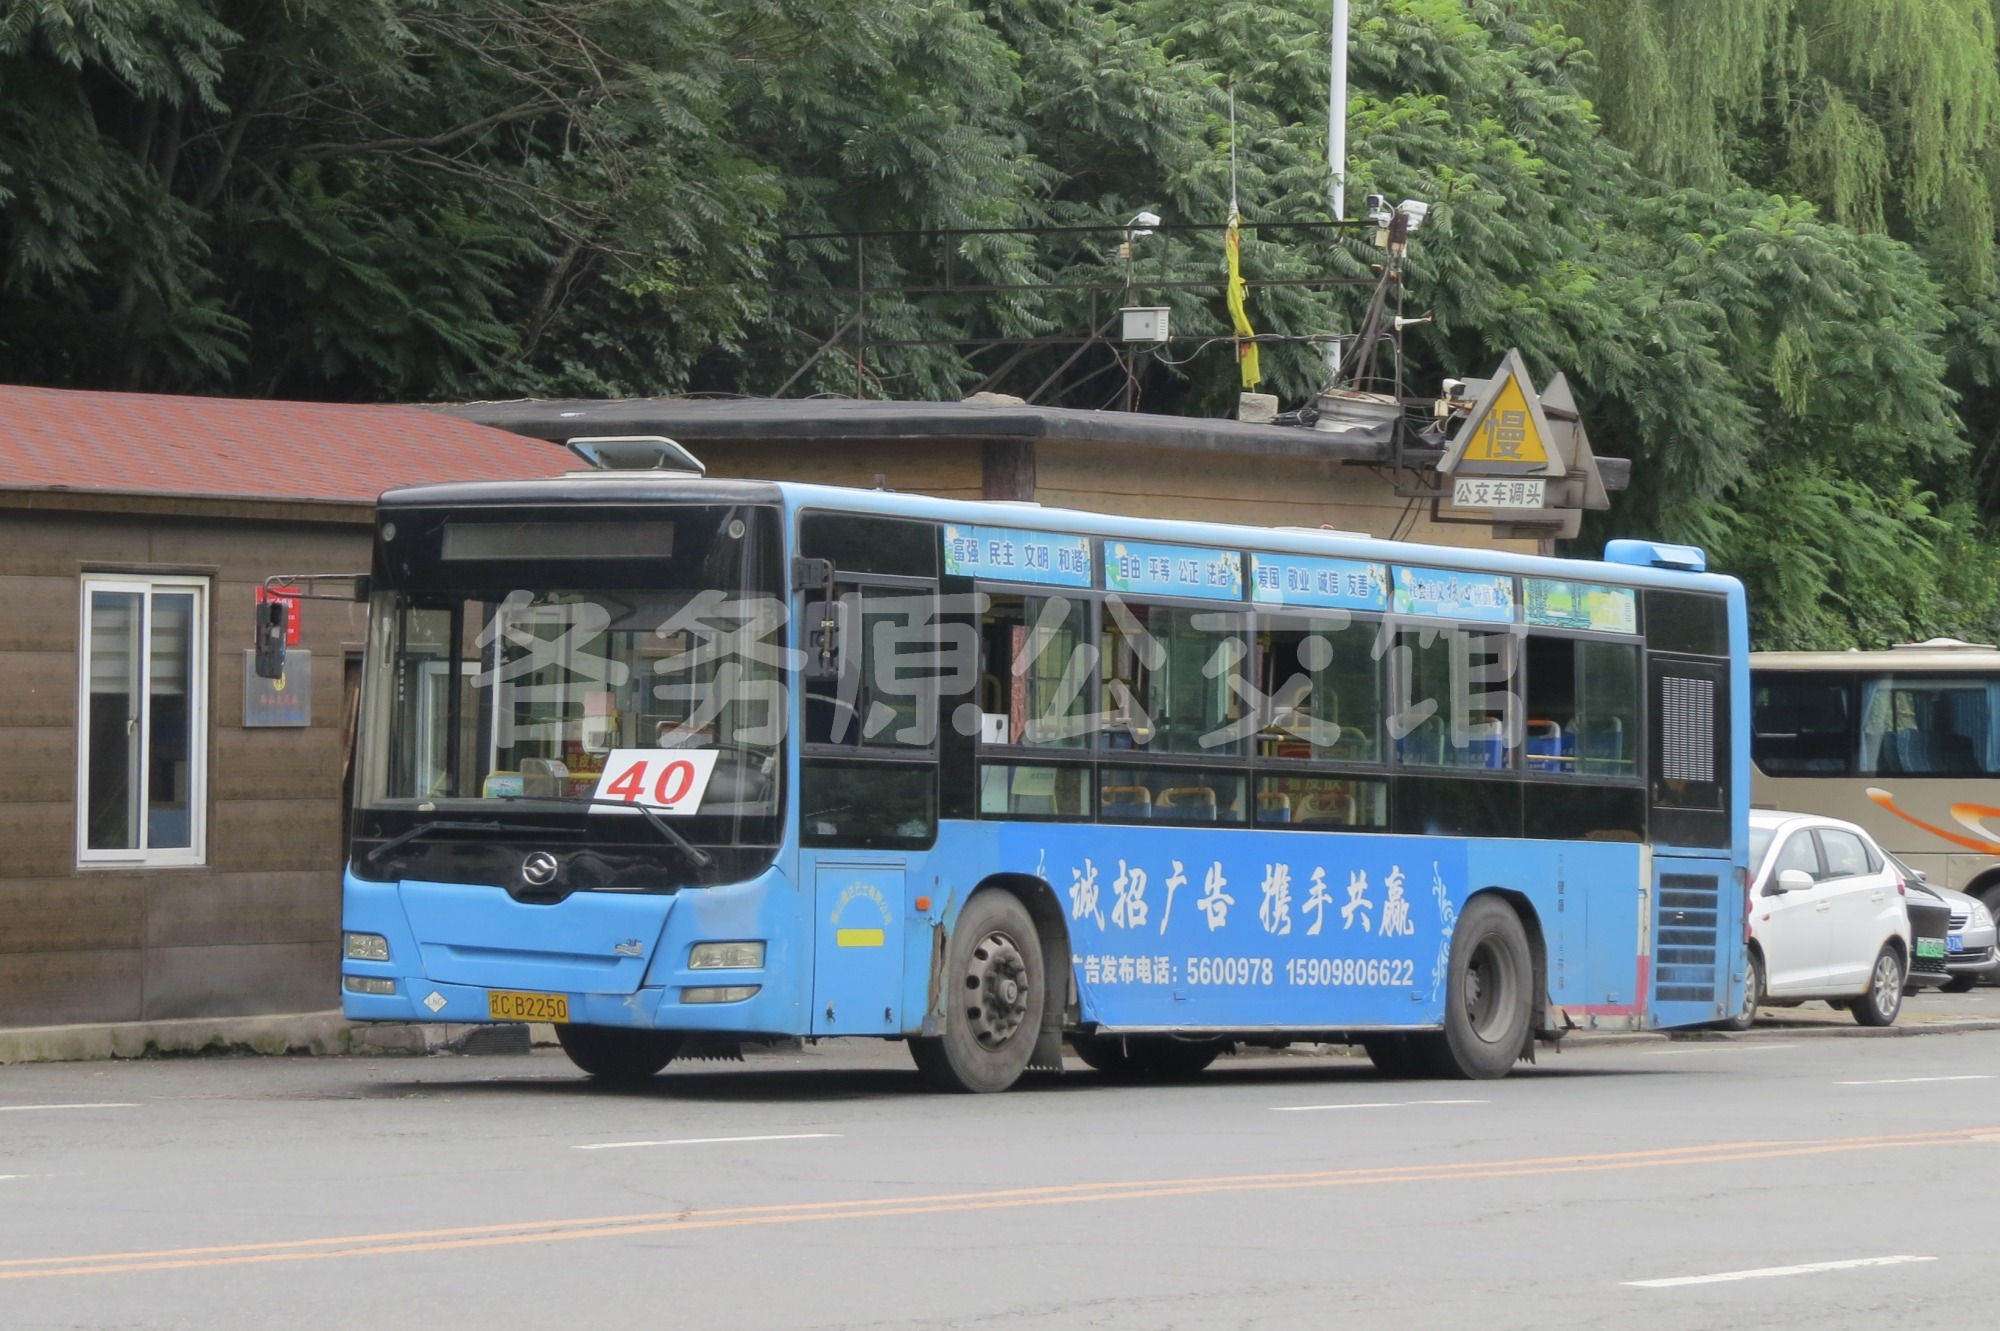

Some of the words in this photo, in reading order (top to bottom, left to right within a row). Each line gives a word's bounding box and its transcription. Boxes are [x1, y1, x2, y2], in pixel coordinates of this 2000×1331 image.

[1482, 408, 1526, 459] 慢
[1456, 482, 1541, 505] 公交车调头
[952, 537, 980, 564] 富强
[988, 540, 1015, 567] 民主
[1023, 543, 1050, 570] 文明
[1057, 547, 1084, 574] 和谐
[1119, 555, 1142, 580] 自由
[1149, 557, 1171, 582] 平等
[1178, 559, 1200, 584] 公正
[1206, 562, 1228, 587] 法治
[1257, 565, 1281, 590] 爱国
[1287, 567, 1311, 592] 敬业
[1317, 569, 1340, 595] 诚信
[1346, 573, 1369, 598] 友善
[605, 759, 696, 805] 40
[1069, 858, 1235, 936] 诚招广告
[1258, 861, 1416, 938] 携手共赢
[1186, 956, 1274, 986] 5600978
[1285, 957, 1415, 987] 15909806622
[427, 996, 445, 1007] LNG
